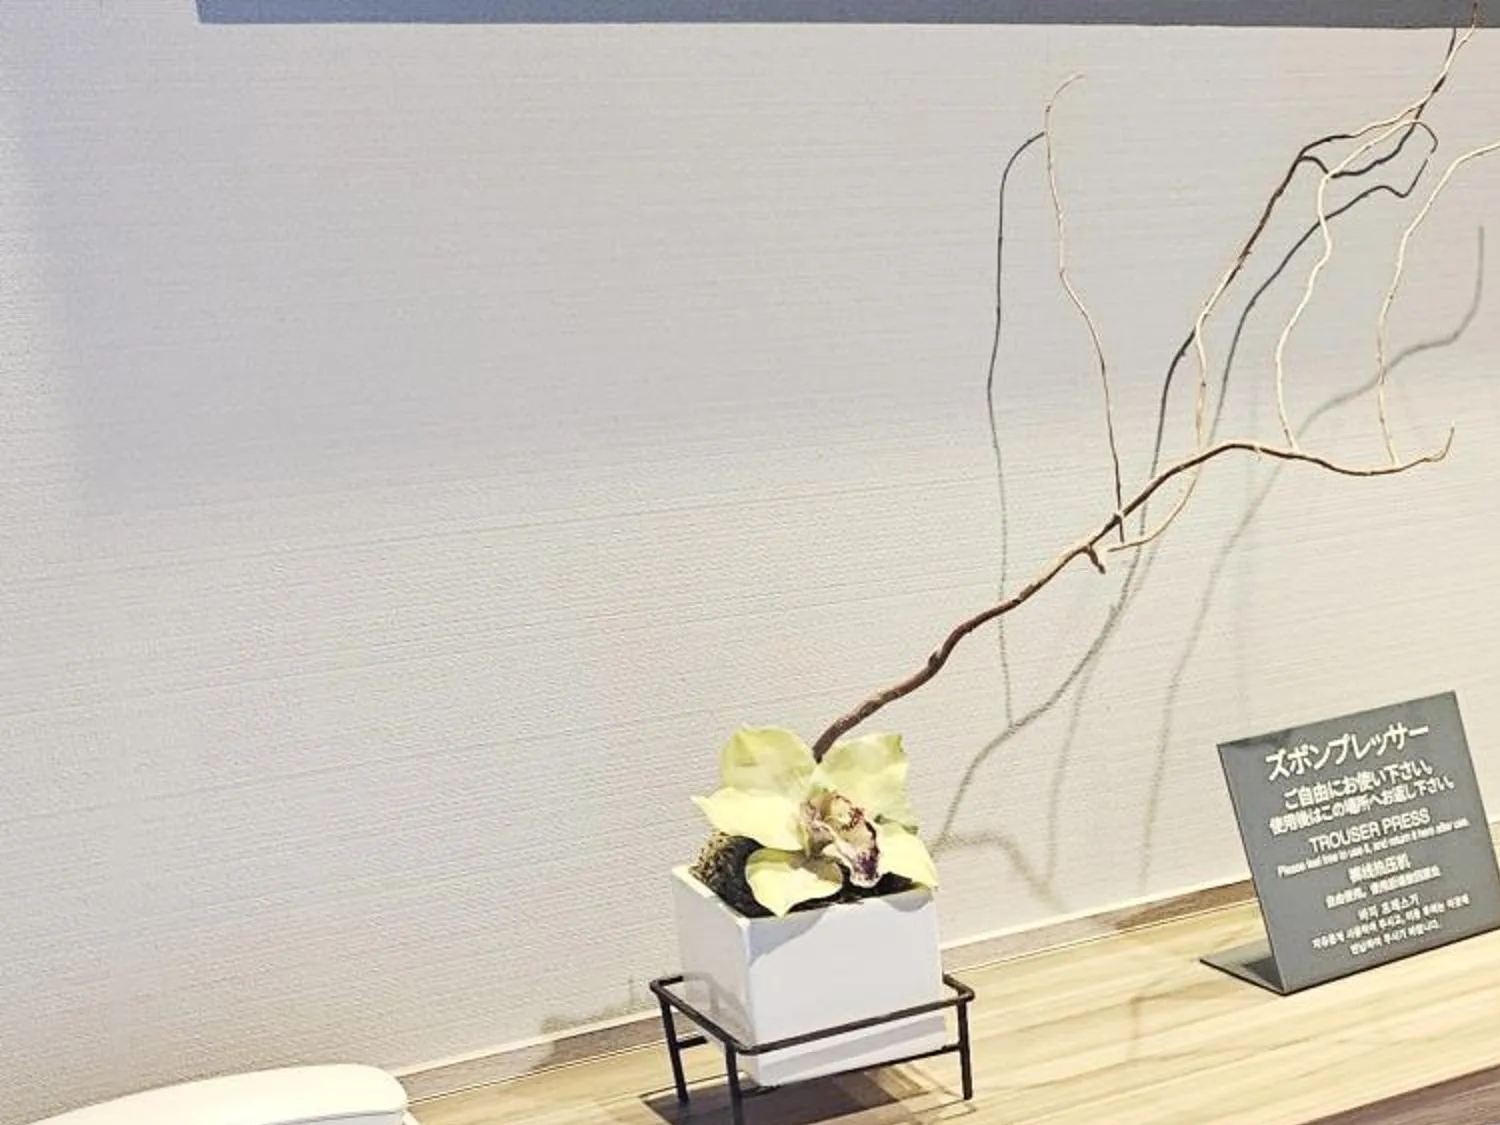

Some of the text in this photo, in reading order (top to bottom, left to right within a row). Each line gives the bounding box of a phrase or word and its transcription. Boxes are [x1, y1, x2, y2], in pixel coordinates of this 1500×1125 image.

[1265, 722, 1429, 781] ズボンプレッサー
[1283, 759, 1433, 810] ご自由にお使い下さい。
[1309, 807, 1430, 853] TROUSER PRESS
